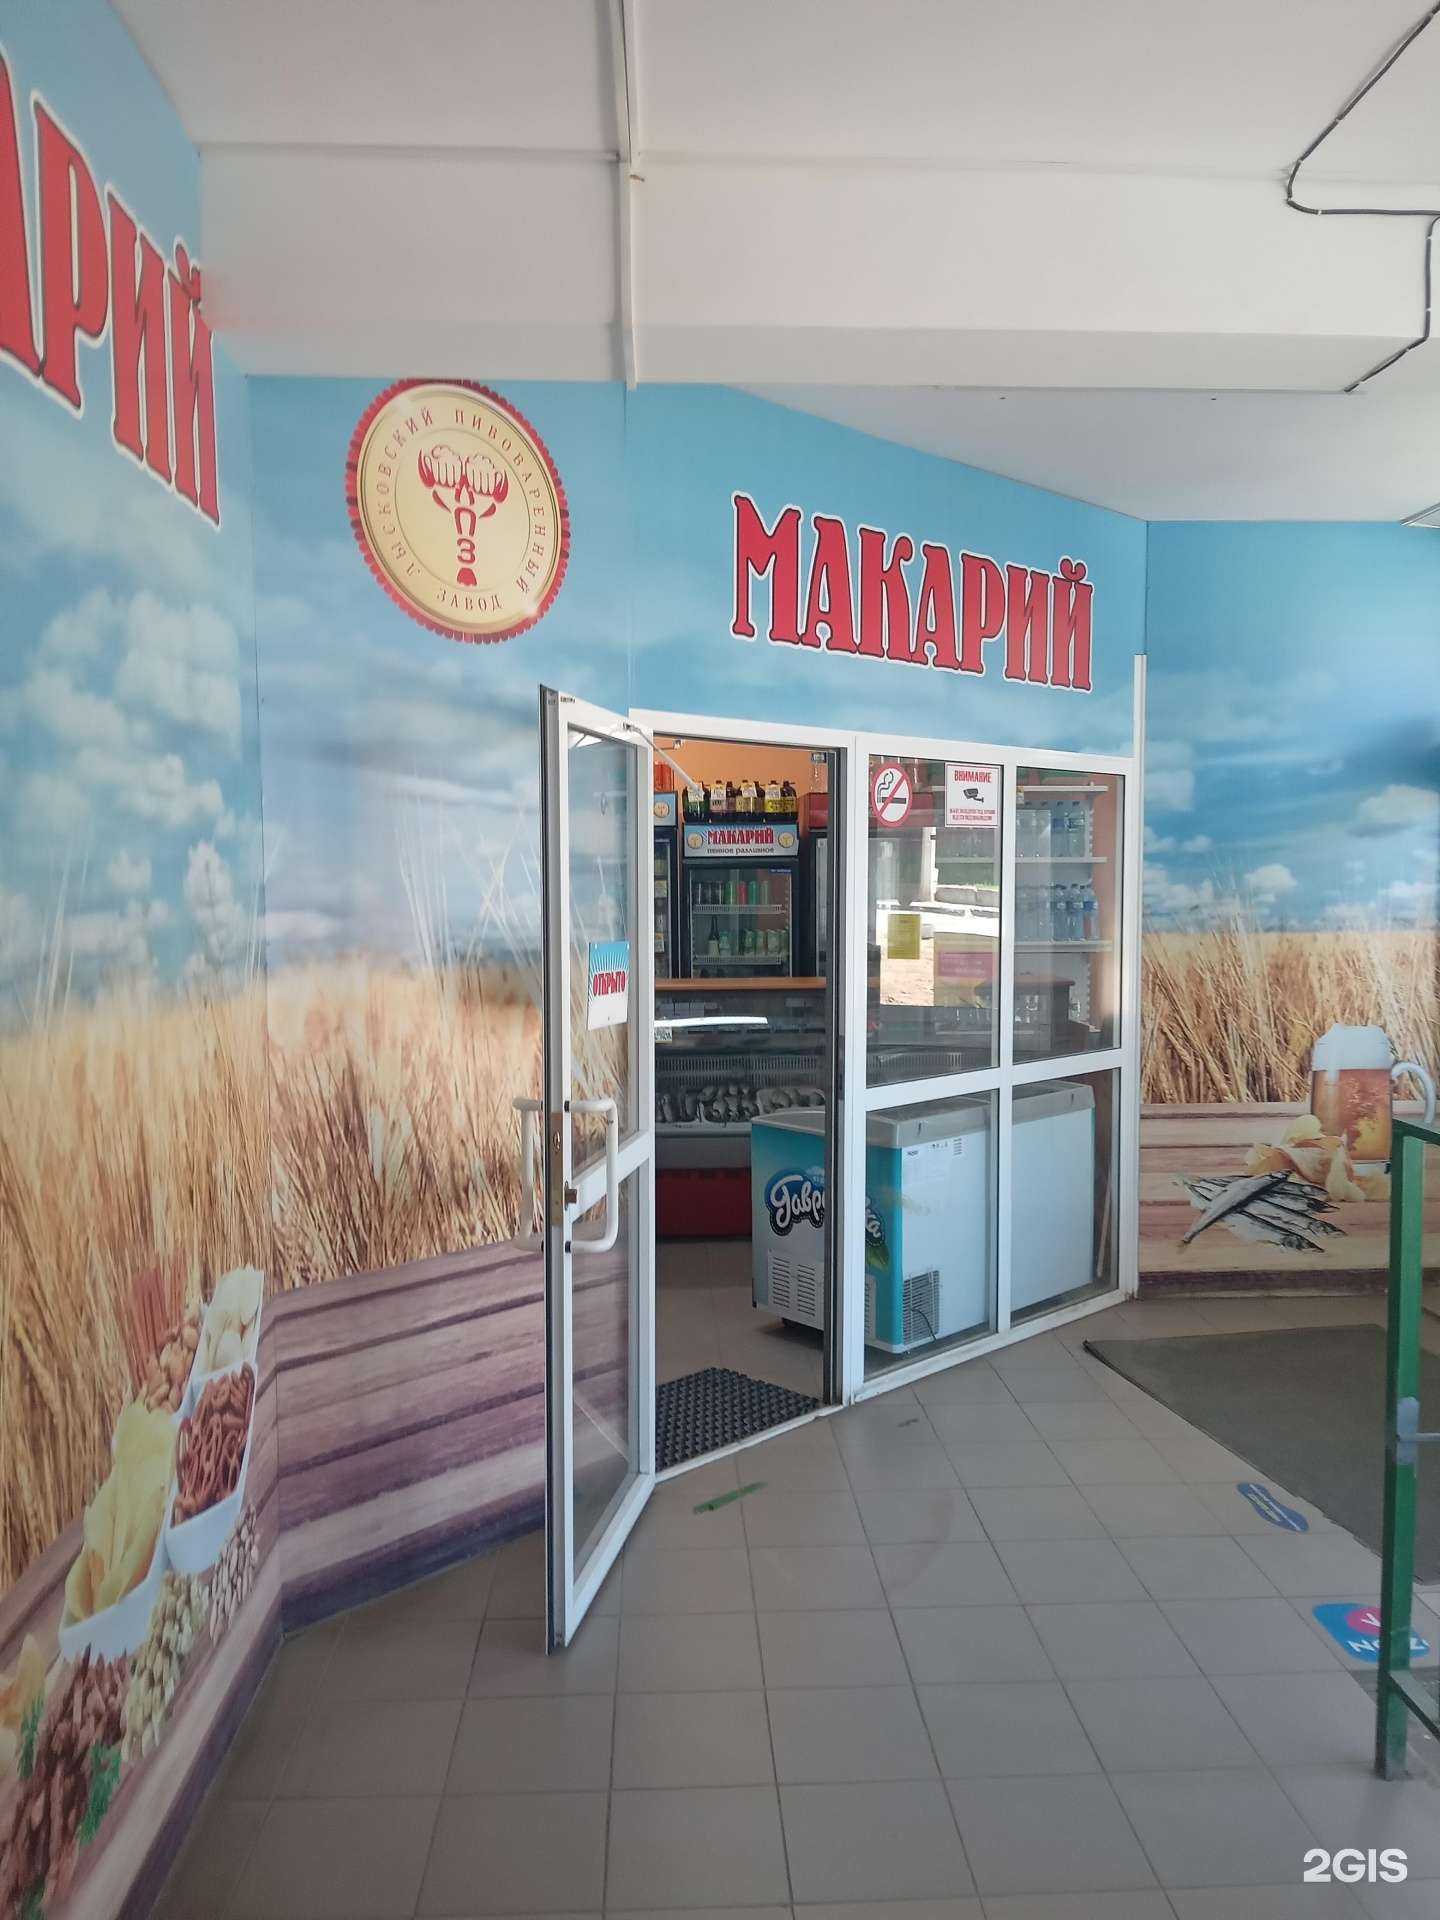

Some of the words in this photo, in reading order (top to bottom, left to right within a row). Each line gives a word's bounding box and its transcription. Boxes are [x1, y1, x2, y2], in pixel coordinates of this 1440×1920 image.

[376, 406, 434, 578] ЛЫСКОВСКИЙ
[454, 407, 547, 594] ПИВОВАРЕННЫЙ
[436, 586, 504, 612] ЗАВОД
[732, 491, 1093, 692] МАКАРИЙ
[954, 769, 992, 783] ВНИМАНИЕ
[707, 826, 774, 845] МАКАРИЙ
[593, 971, 625, 996] ОТКРЫТО
